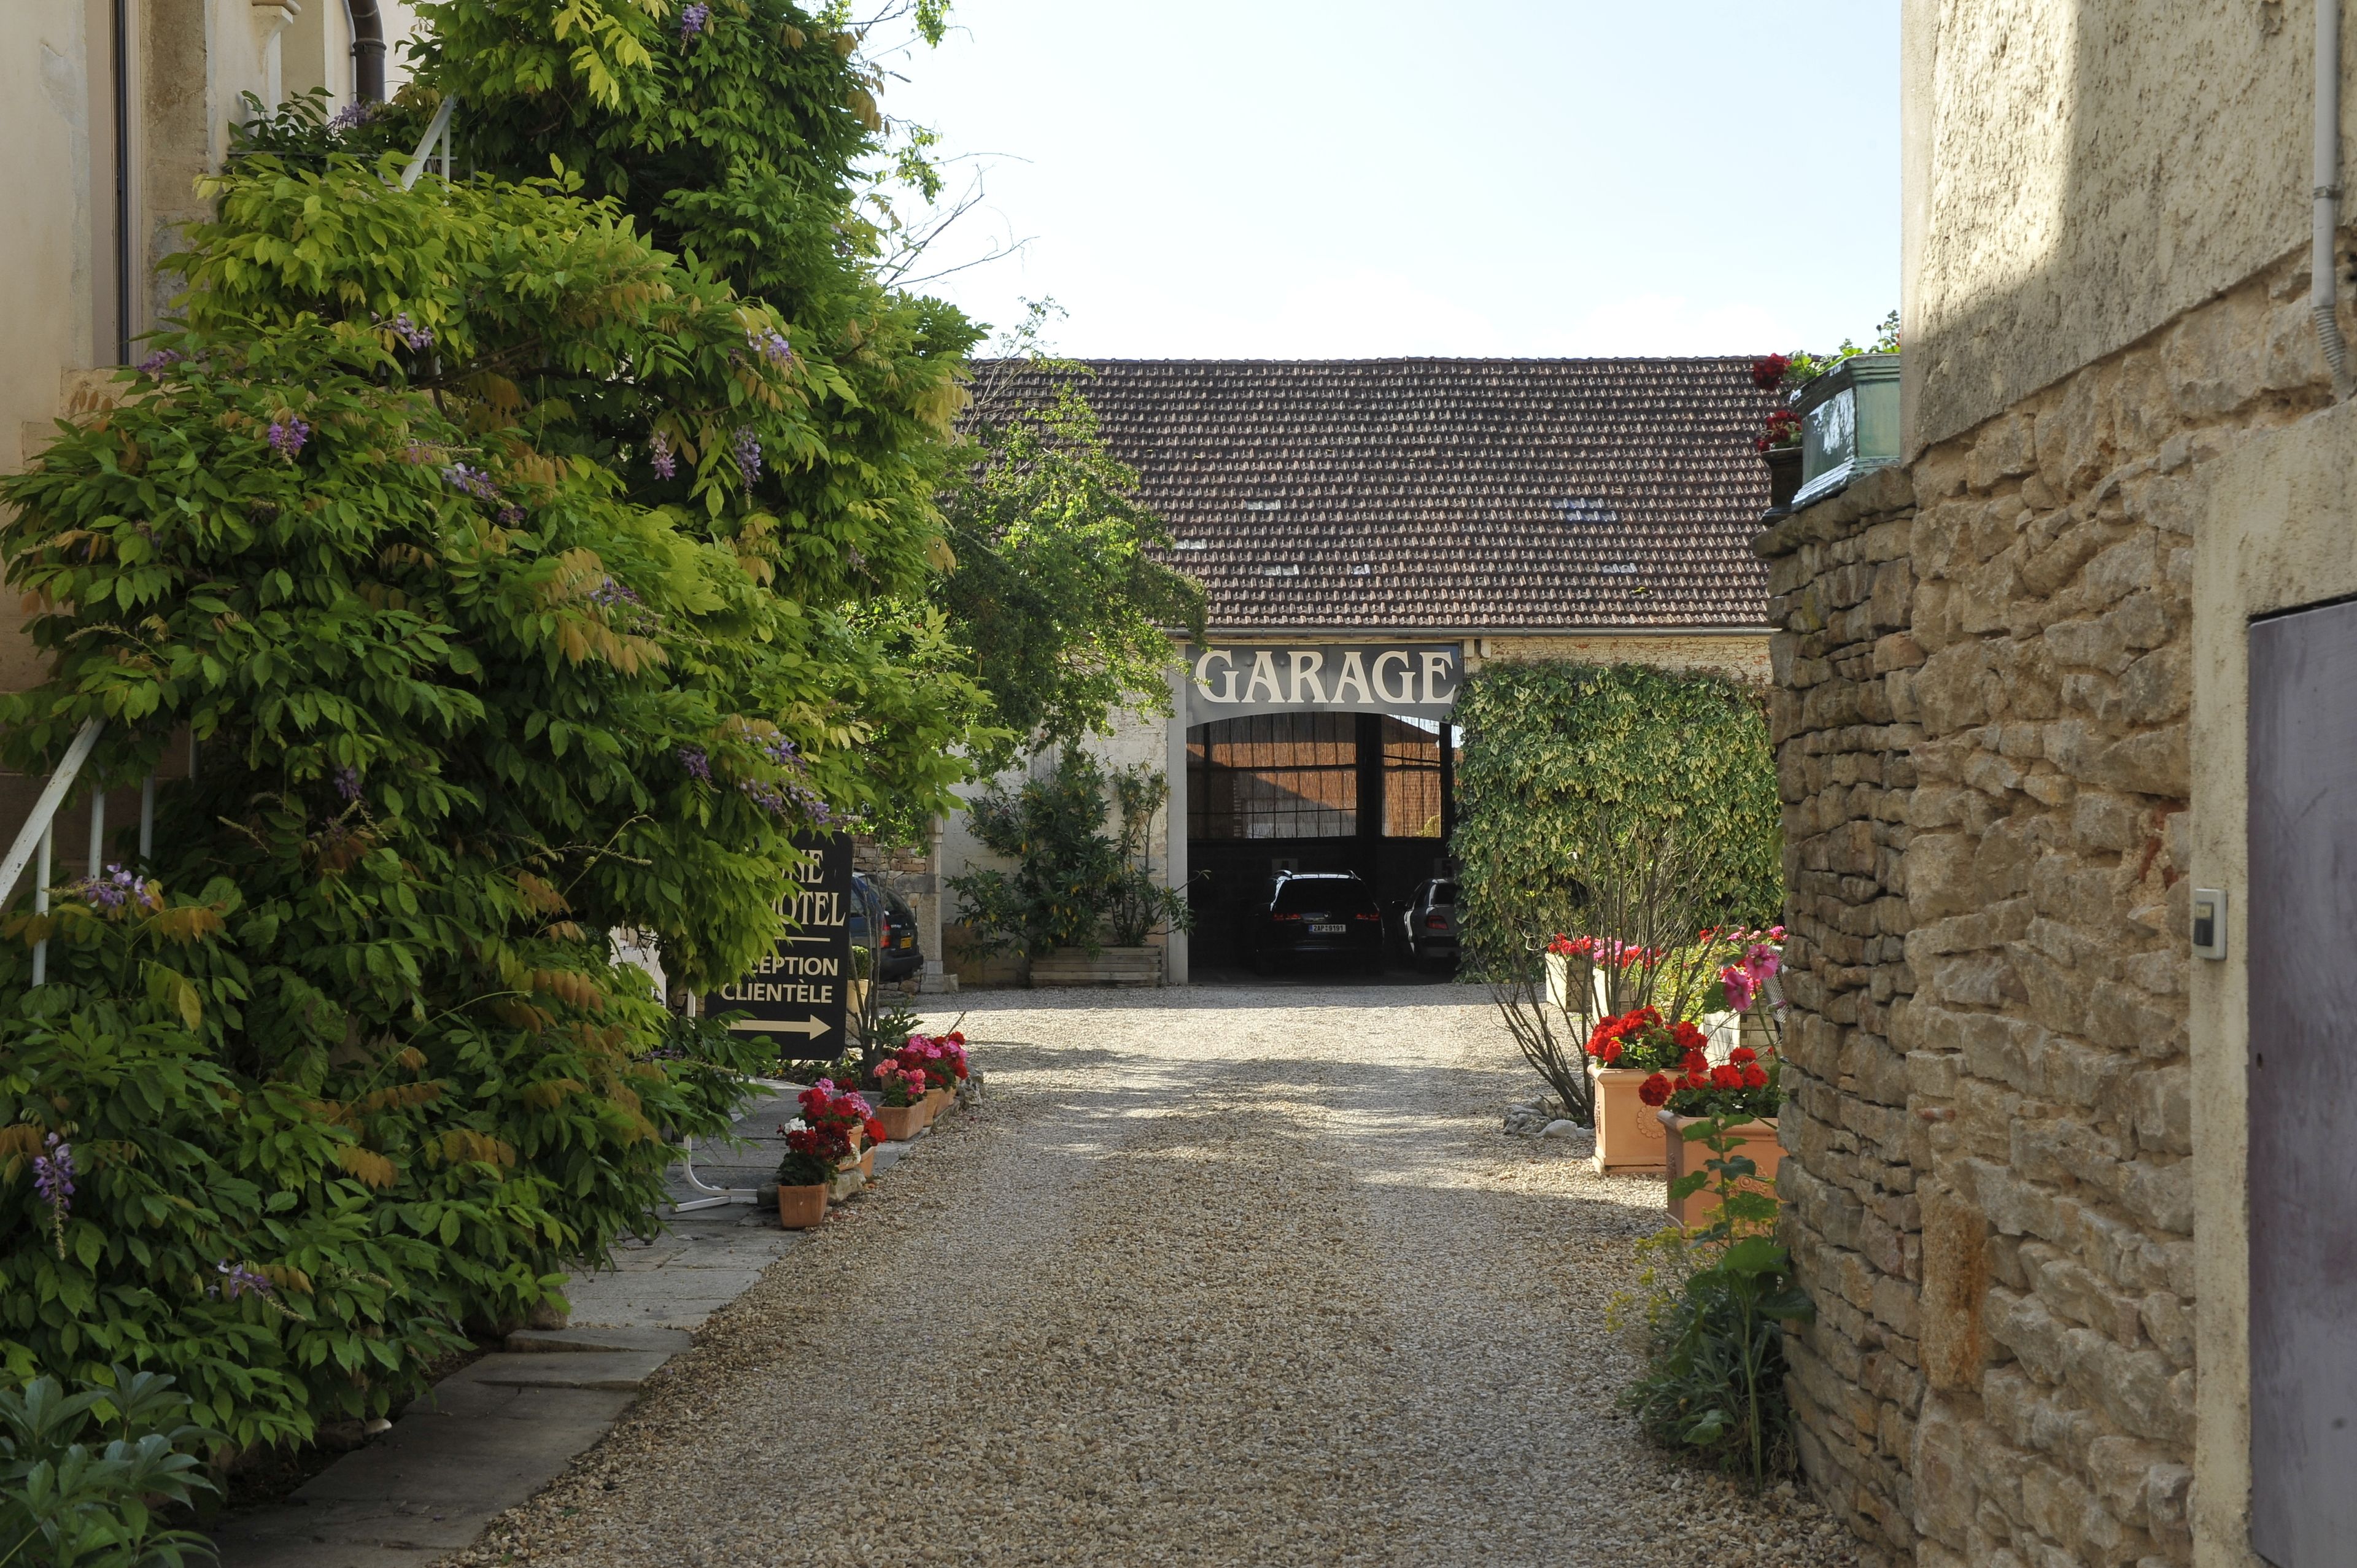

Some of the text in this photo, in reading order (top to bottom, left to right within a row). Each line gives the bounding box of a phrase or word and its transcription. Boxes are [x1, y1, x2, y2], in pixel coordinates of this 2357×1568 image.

[1195, 650, 1457, 705] GARAGE
[770, 890, 846, 927] OTEL
[751, 956, 838, 976] EPTION
[721, 979, 833, 1003] CLIENTÈLE
